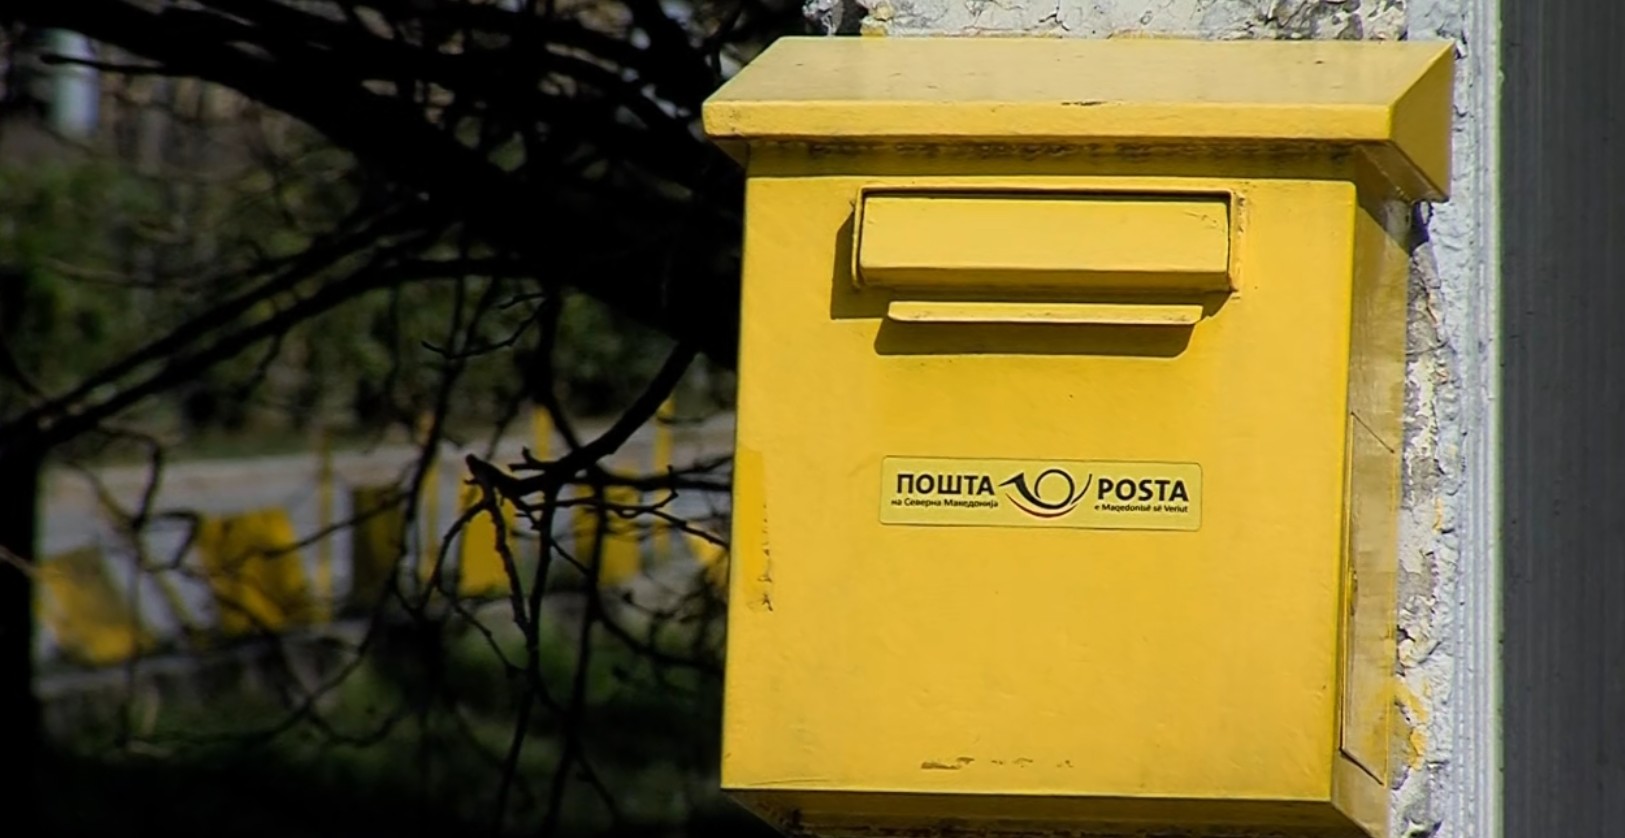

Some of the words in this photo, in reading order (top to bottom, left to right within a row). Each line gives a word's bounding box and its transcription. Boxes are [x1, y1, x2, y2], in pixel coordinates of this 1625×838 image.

[897, 473, 995, 495] ПОШТА
[1098, 478, 1189, 502] POSTA
[904, 498, 941, 507] Северна
[944, 499, 999, 508] Македонија
[1164, 504, 1188, 512] Veriut
